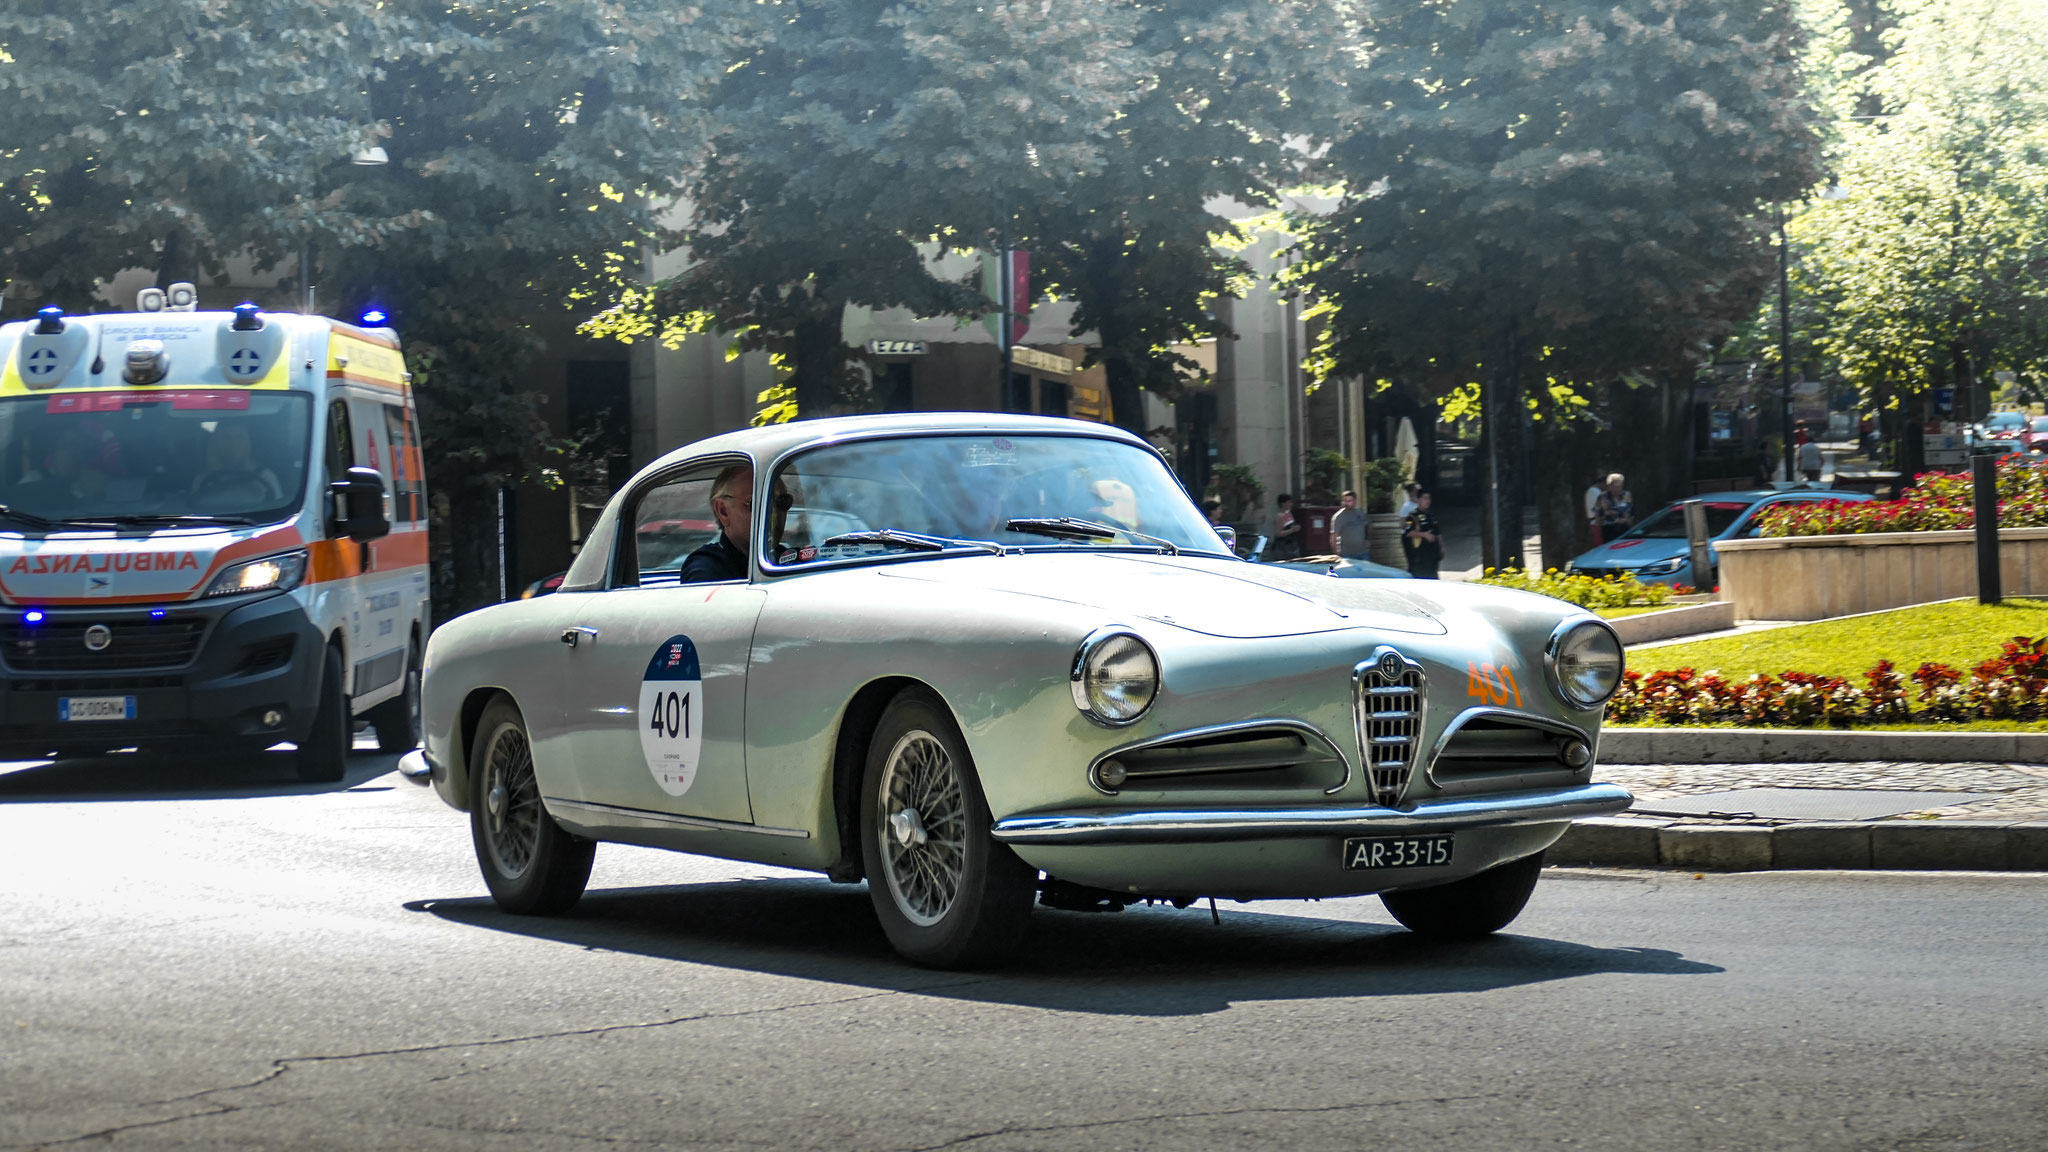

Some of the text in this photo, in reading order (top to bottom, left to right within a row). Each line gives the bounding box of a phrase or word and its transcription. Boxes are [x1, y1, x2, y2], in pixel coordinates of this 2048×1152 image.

[1467, 661, 1523, 708] 401
[650, 691, 691, 739] 401
[1351, 838, 1448, 870] AR-33-15
